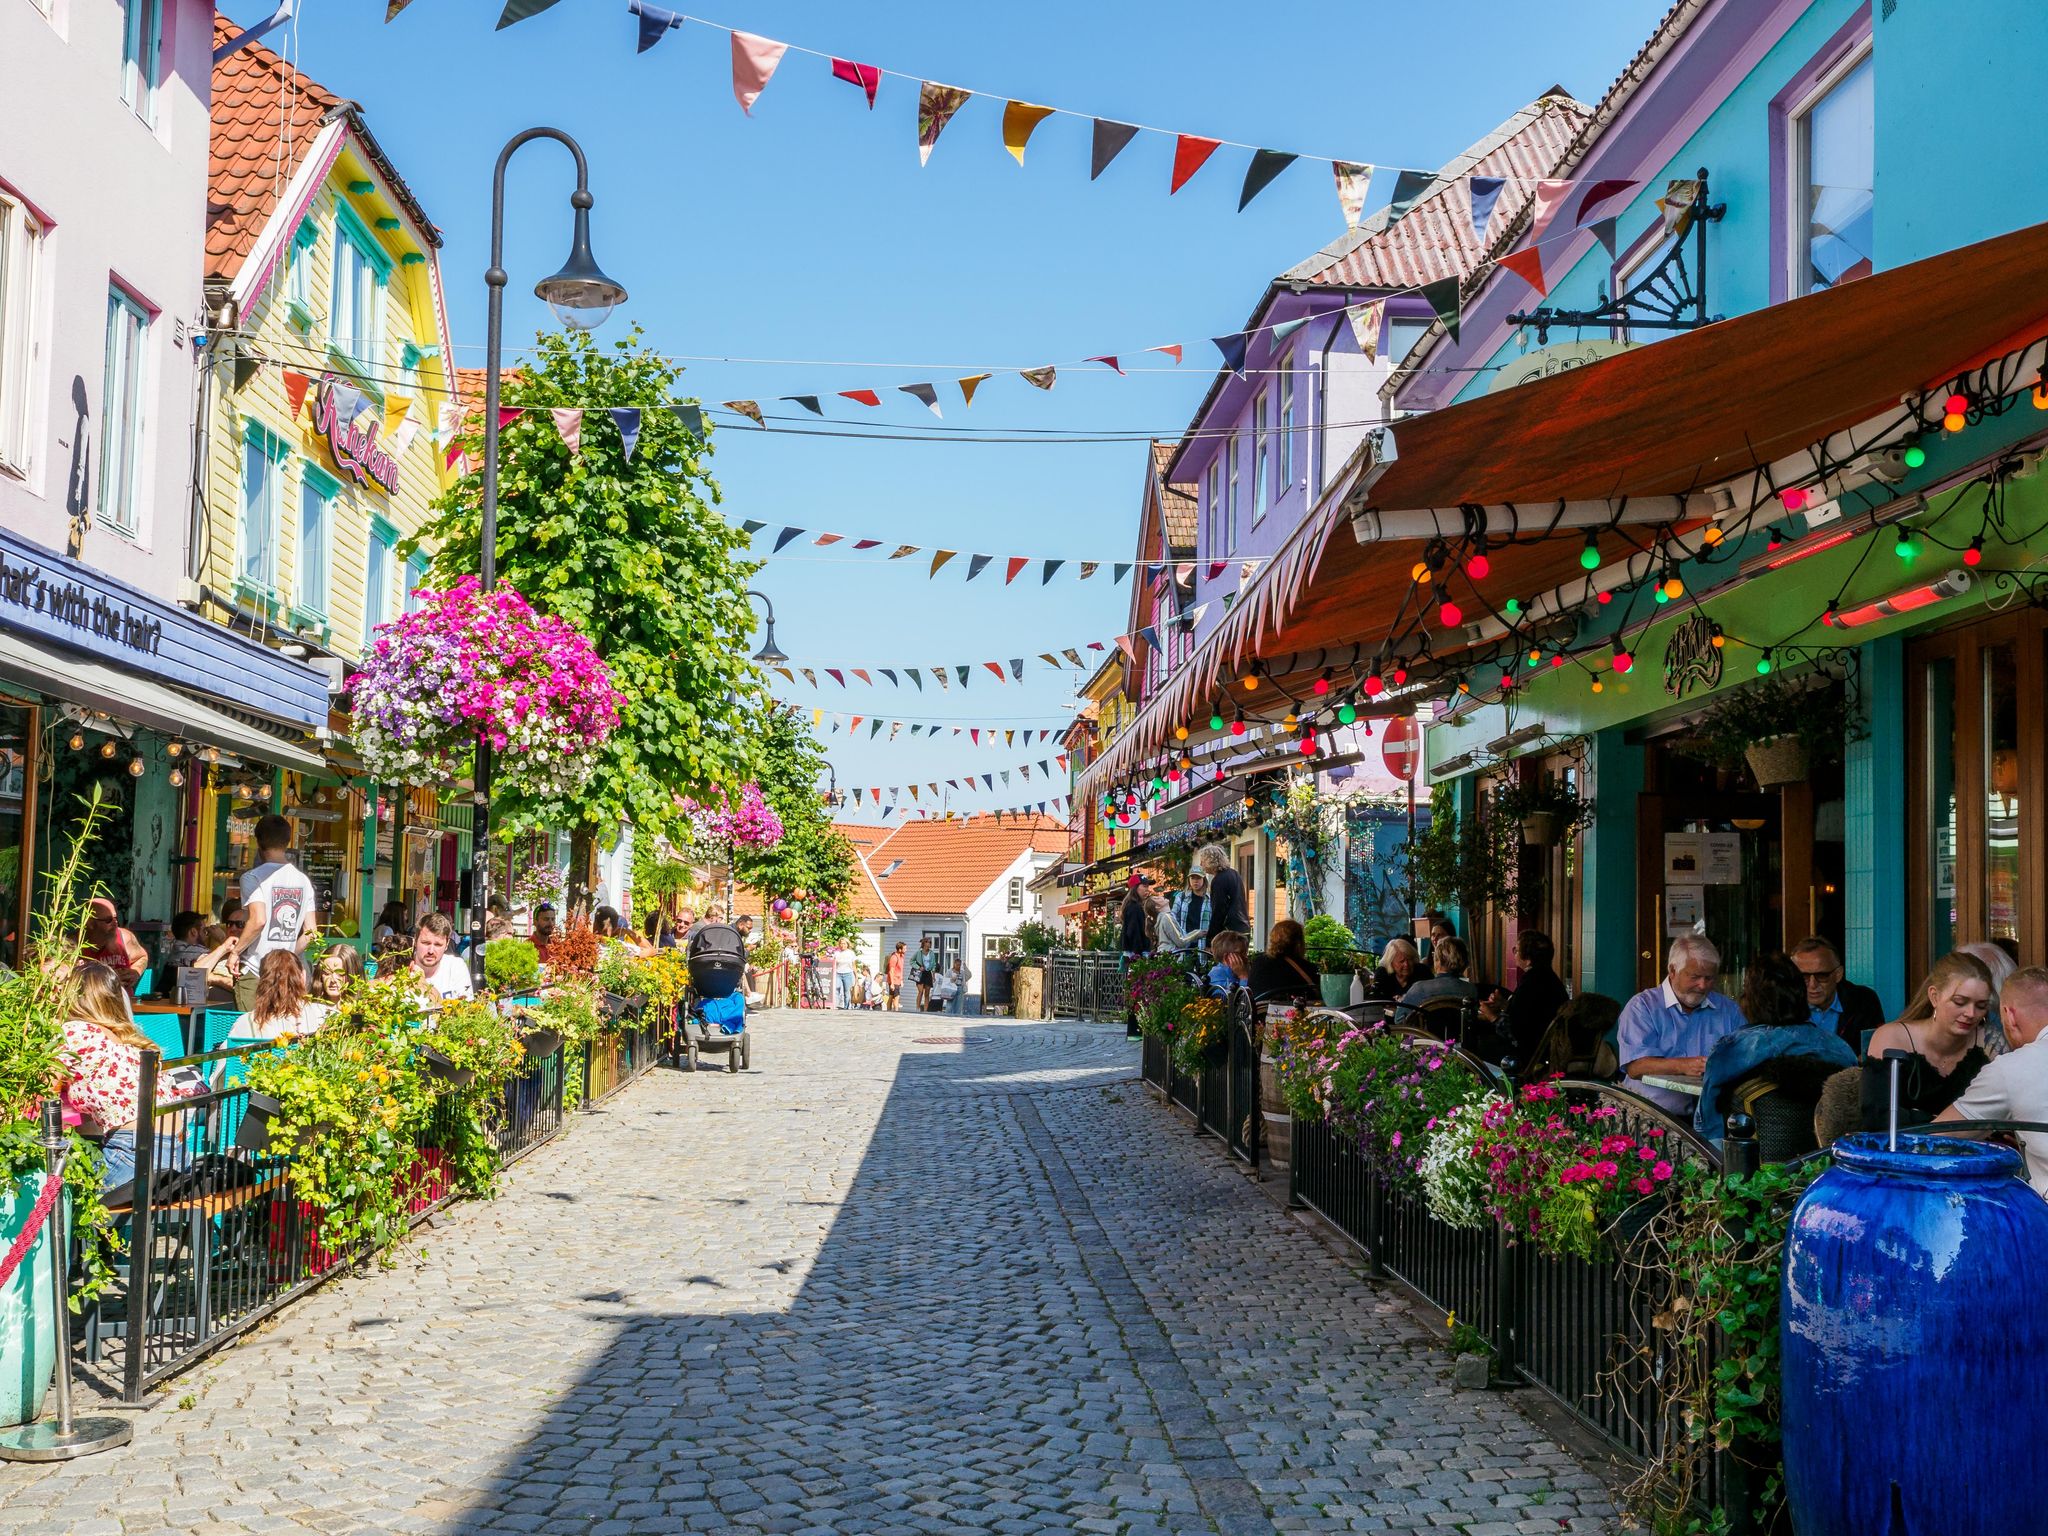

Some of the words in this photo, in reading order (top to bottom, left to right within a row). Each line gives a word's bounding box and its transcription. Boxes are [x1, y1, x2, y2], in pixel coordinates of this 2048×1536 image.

[50, 582, 89, 632] with
[93, 595, 120, 642] the
[123, 605, 161, 657] hair?
[226, 816, 257, 838] #haneka
